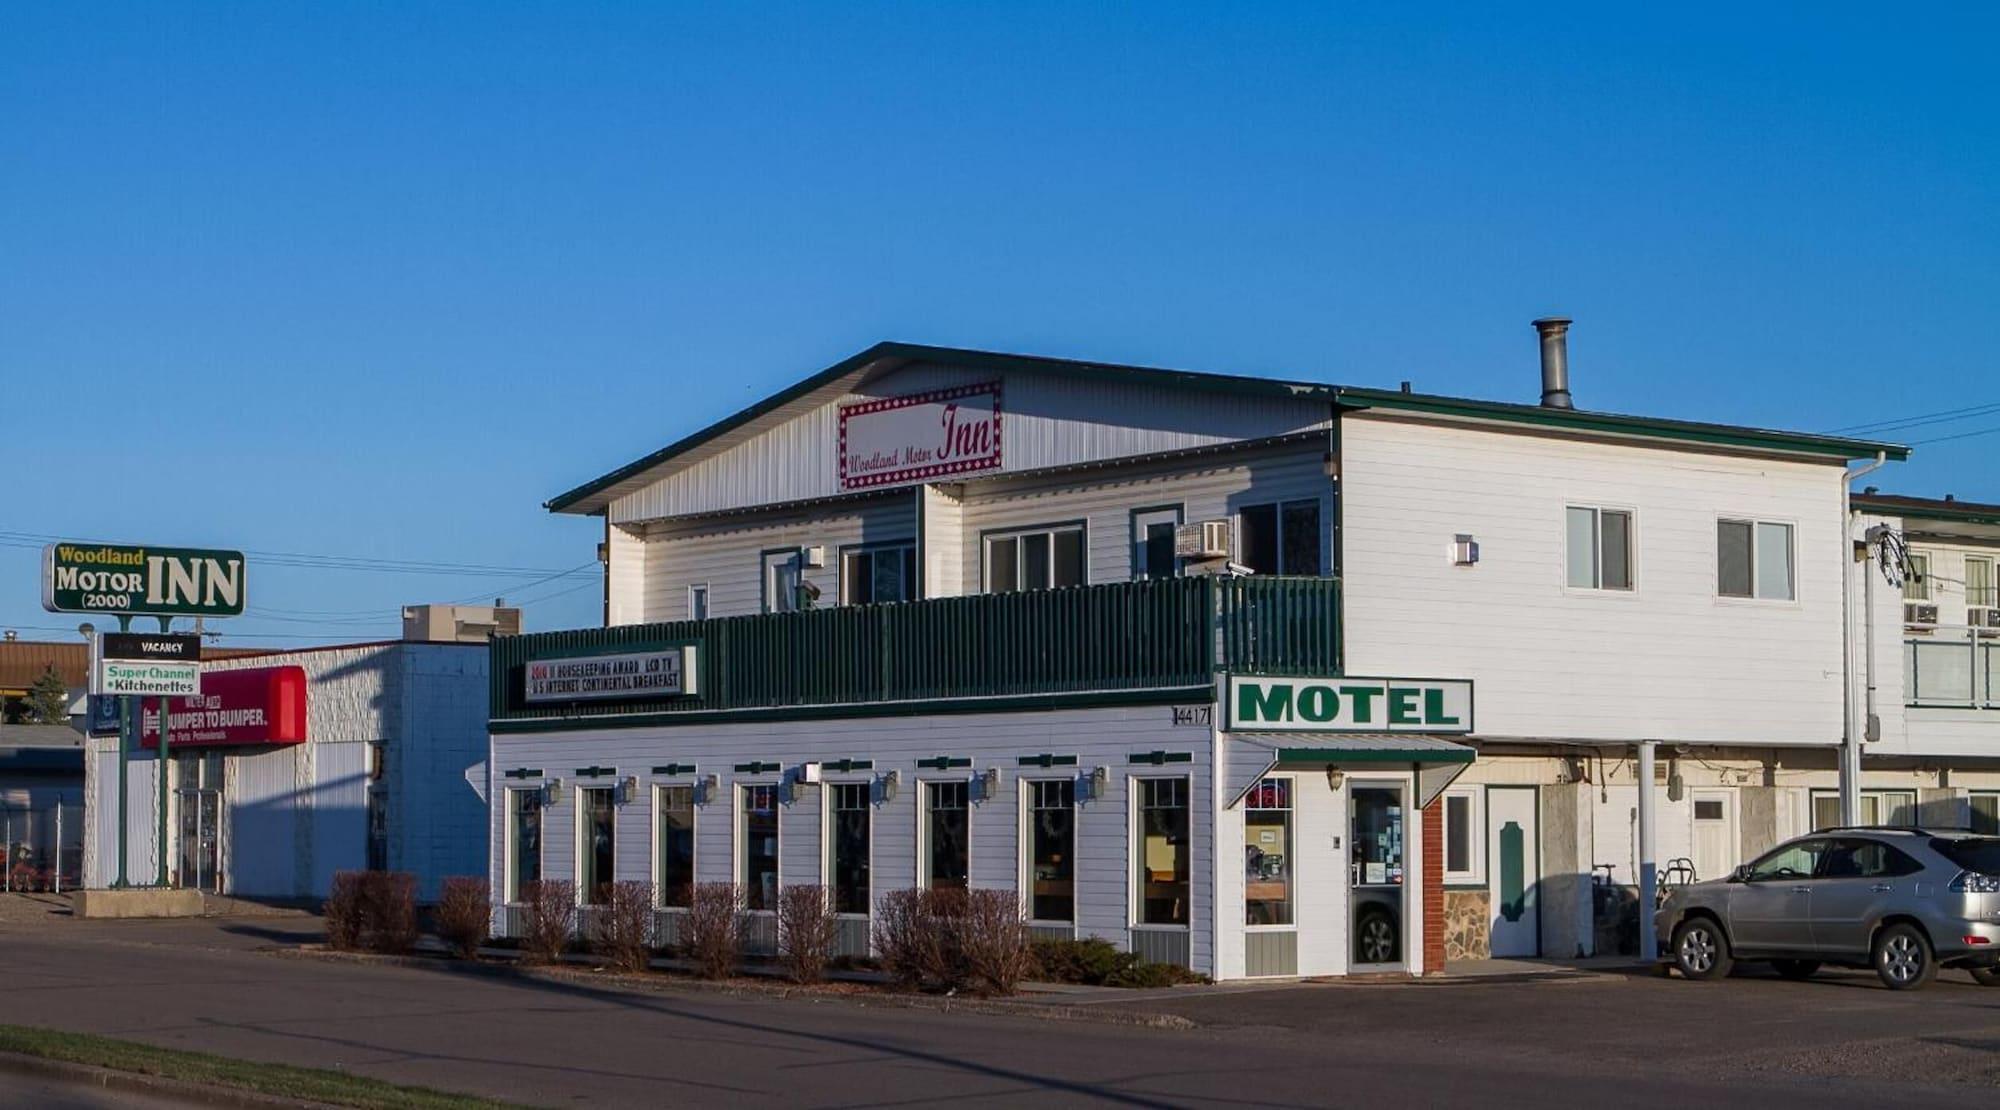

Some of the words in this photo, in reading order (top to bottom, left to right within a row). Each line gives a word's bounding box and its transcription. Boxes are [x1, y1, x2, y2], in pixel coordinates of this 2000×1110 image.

[849, 449, 897, 473] Woodland
[902, 445, 932, 465] Motor
[937, 403, 991, 460] Inn
[59, 546, 144, 565] Woodland
[146, 556, 240, 607] INN
[82, 593, 131, 609] (2000)
[141, 642, 183, 653] VACANCY
[108, 666, 147, 678] Super
[149, 667, 195, 679] Channel
[612, 660, 639, 674] AWARD
[662, 656, 673, 672] TV
[115, 680, 194, 693] Kitchenettes
[545, 679, 580, 694] INTERNET
[582, 674, 632, 692] CONTINENTAL
[632, 672, 677, 690] BREAKFAST
[1238, 684, 1459, 725] MOTEL
[205, 711, 219, 728] TO
